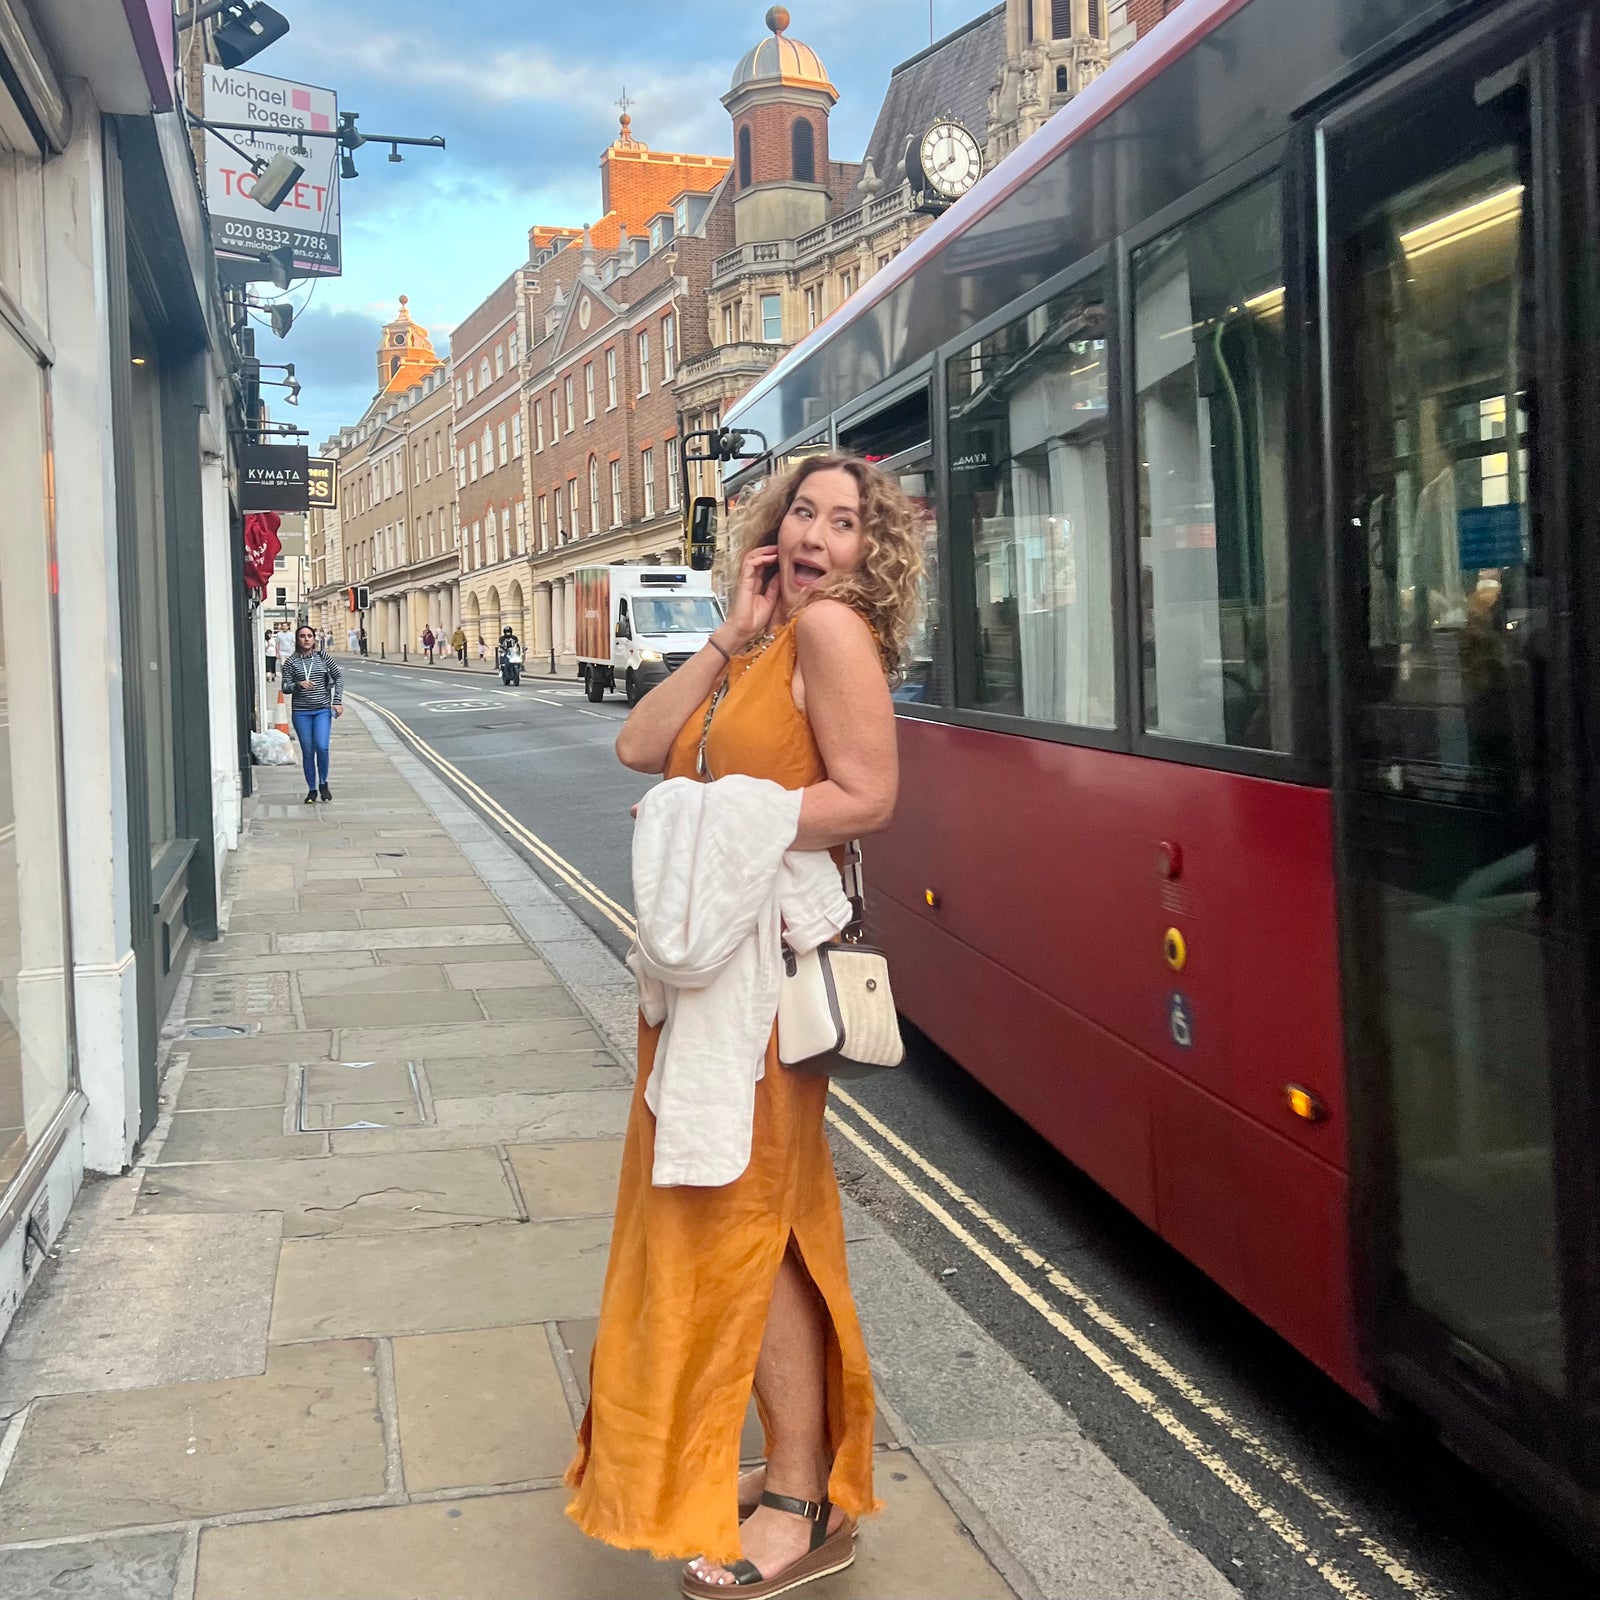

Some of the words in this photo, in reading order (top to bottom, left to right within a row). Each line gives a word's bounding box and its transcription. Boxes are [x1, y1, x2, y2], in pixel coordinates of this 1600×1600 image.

[212, 75, 286, 106] Michael
[247, 102, 305, 129] Rogers
[233, 133, 312, 158] Commercal
[281, 182, 326, 211] ET
[225, 222, 252, 238] 020
[256, 227, 290, 244] 8332
[293, 233, 327, 251] 7788
[248, 468, 300, 480] KYMATA
